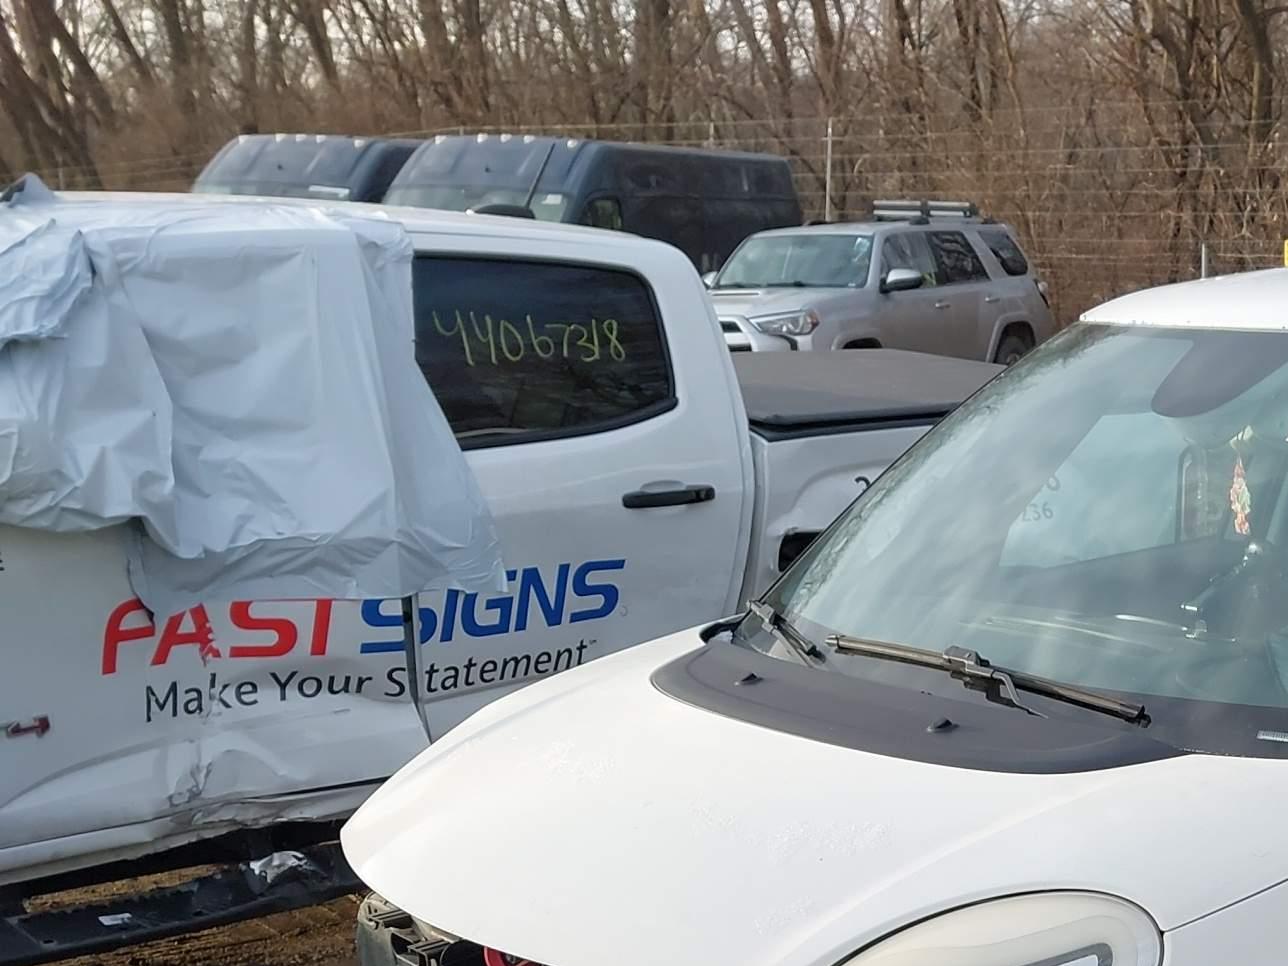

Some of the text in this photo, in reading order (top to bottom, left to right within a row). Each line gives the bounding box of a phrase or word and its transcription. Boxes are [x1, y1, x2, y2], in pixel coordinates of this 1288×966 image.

[432, 309, 626, 367] 44067318
[145, 672, 259, 723] Make
[269, 670, 372, 701] Your
